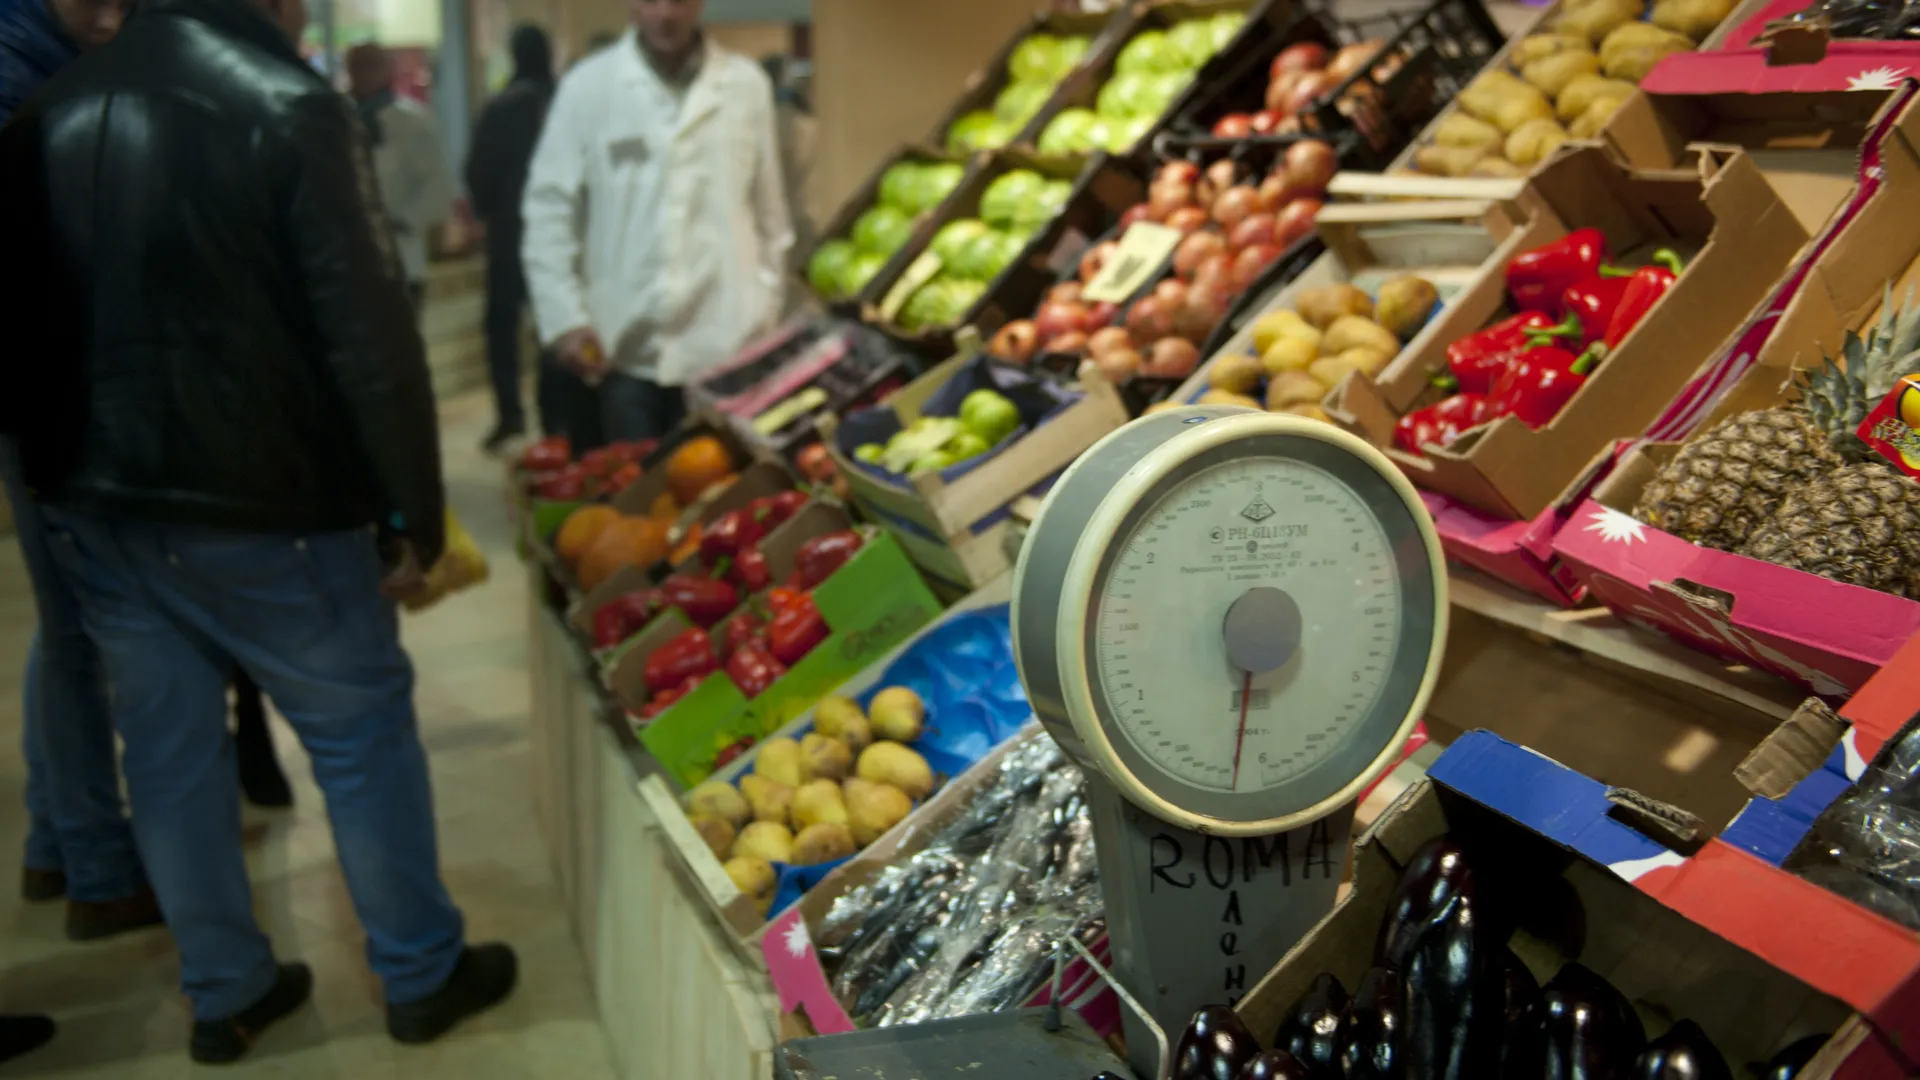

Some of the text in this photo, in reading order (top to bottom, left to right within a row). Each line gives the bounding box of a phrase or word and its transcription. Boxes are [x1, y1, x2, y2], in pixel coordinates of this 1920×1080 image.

[1254, 481, 1264, 491] 3
[1351, 541, 1359, 553] 4
[1146, 551, 1155, 564] 2
[1119, 622, 1140, 632] 1500
[1351, 671, 1360, 682] 5
[1137, 688, 1144, 701] 1
[1258, 752, 1267, 764] 6
[1151, 818, 1339, 893] ROMA
